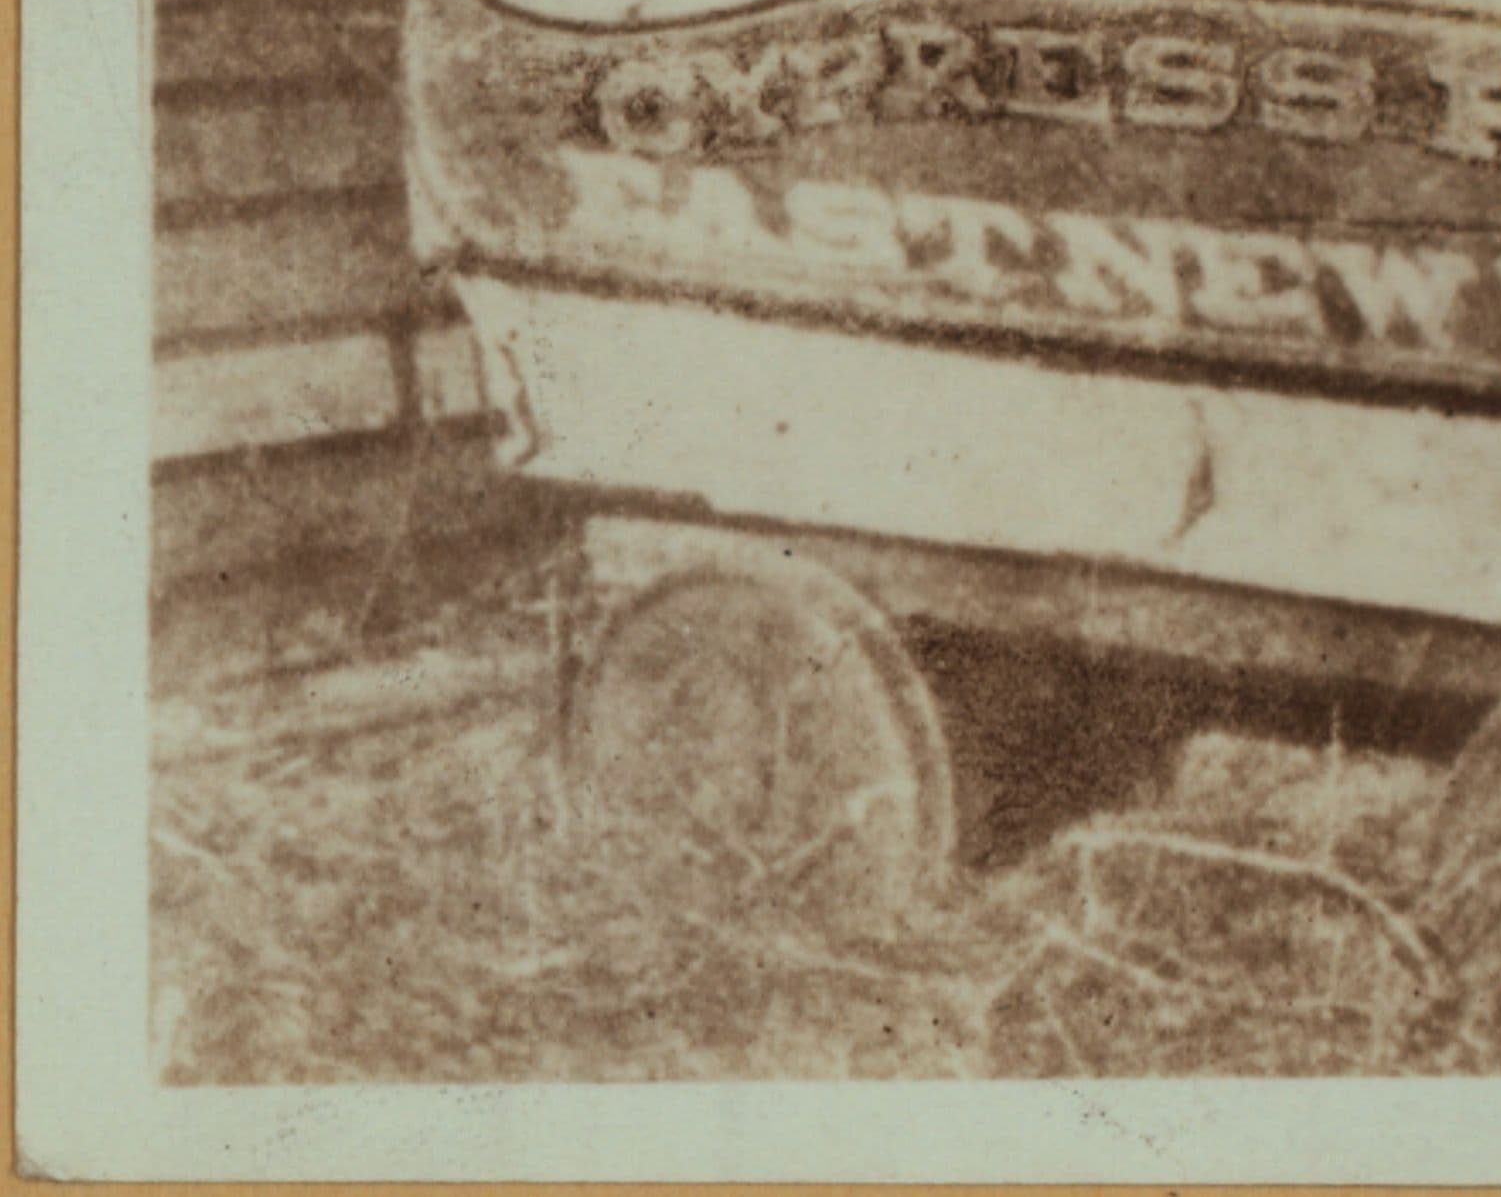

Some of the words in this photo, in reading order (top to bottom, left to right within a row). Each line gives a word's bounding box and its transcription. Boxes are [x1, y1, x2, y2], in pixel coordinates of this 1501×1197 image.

[602, 18, 1376, 156] CYPRESS
[556, 144, 1050, 307] EAST
[1042, 210, 1482, 362] NEW
